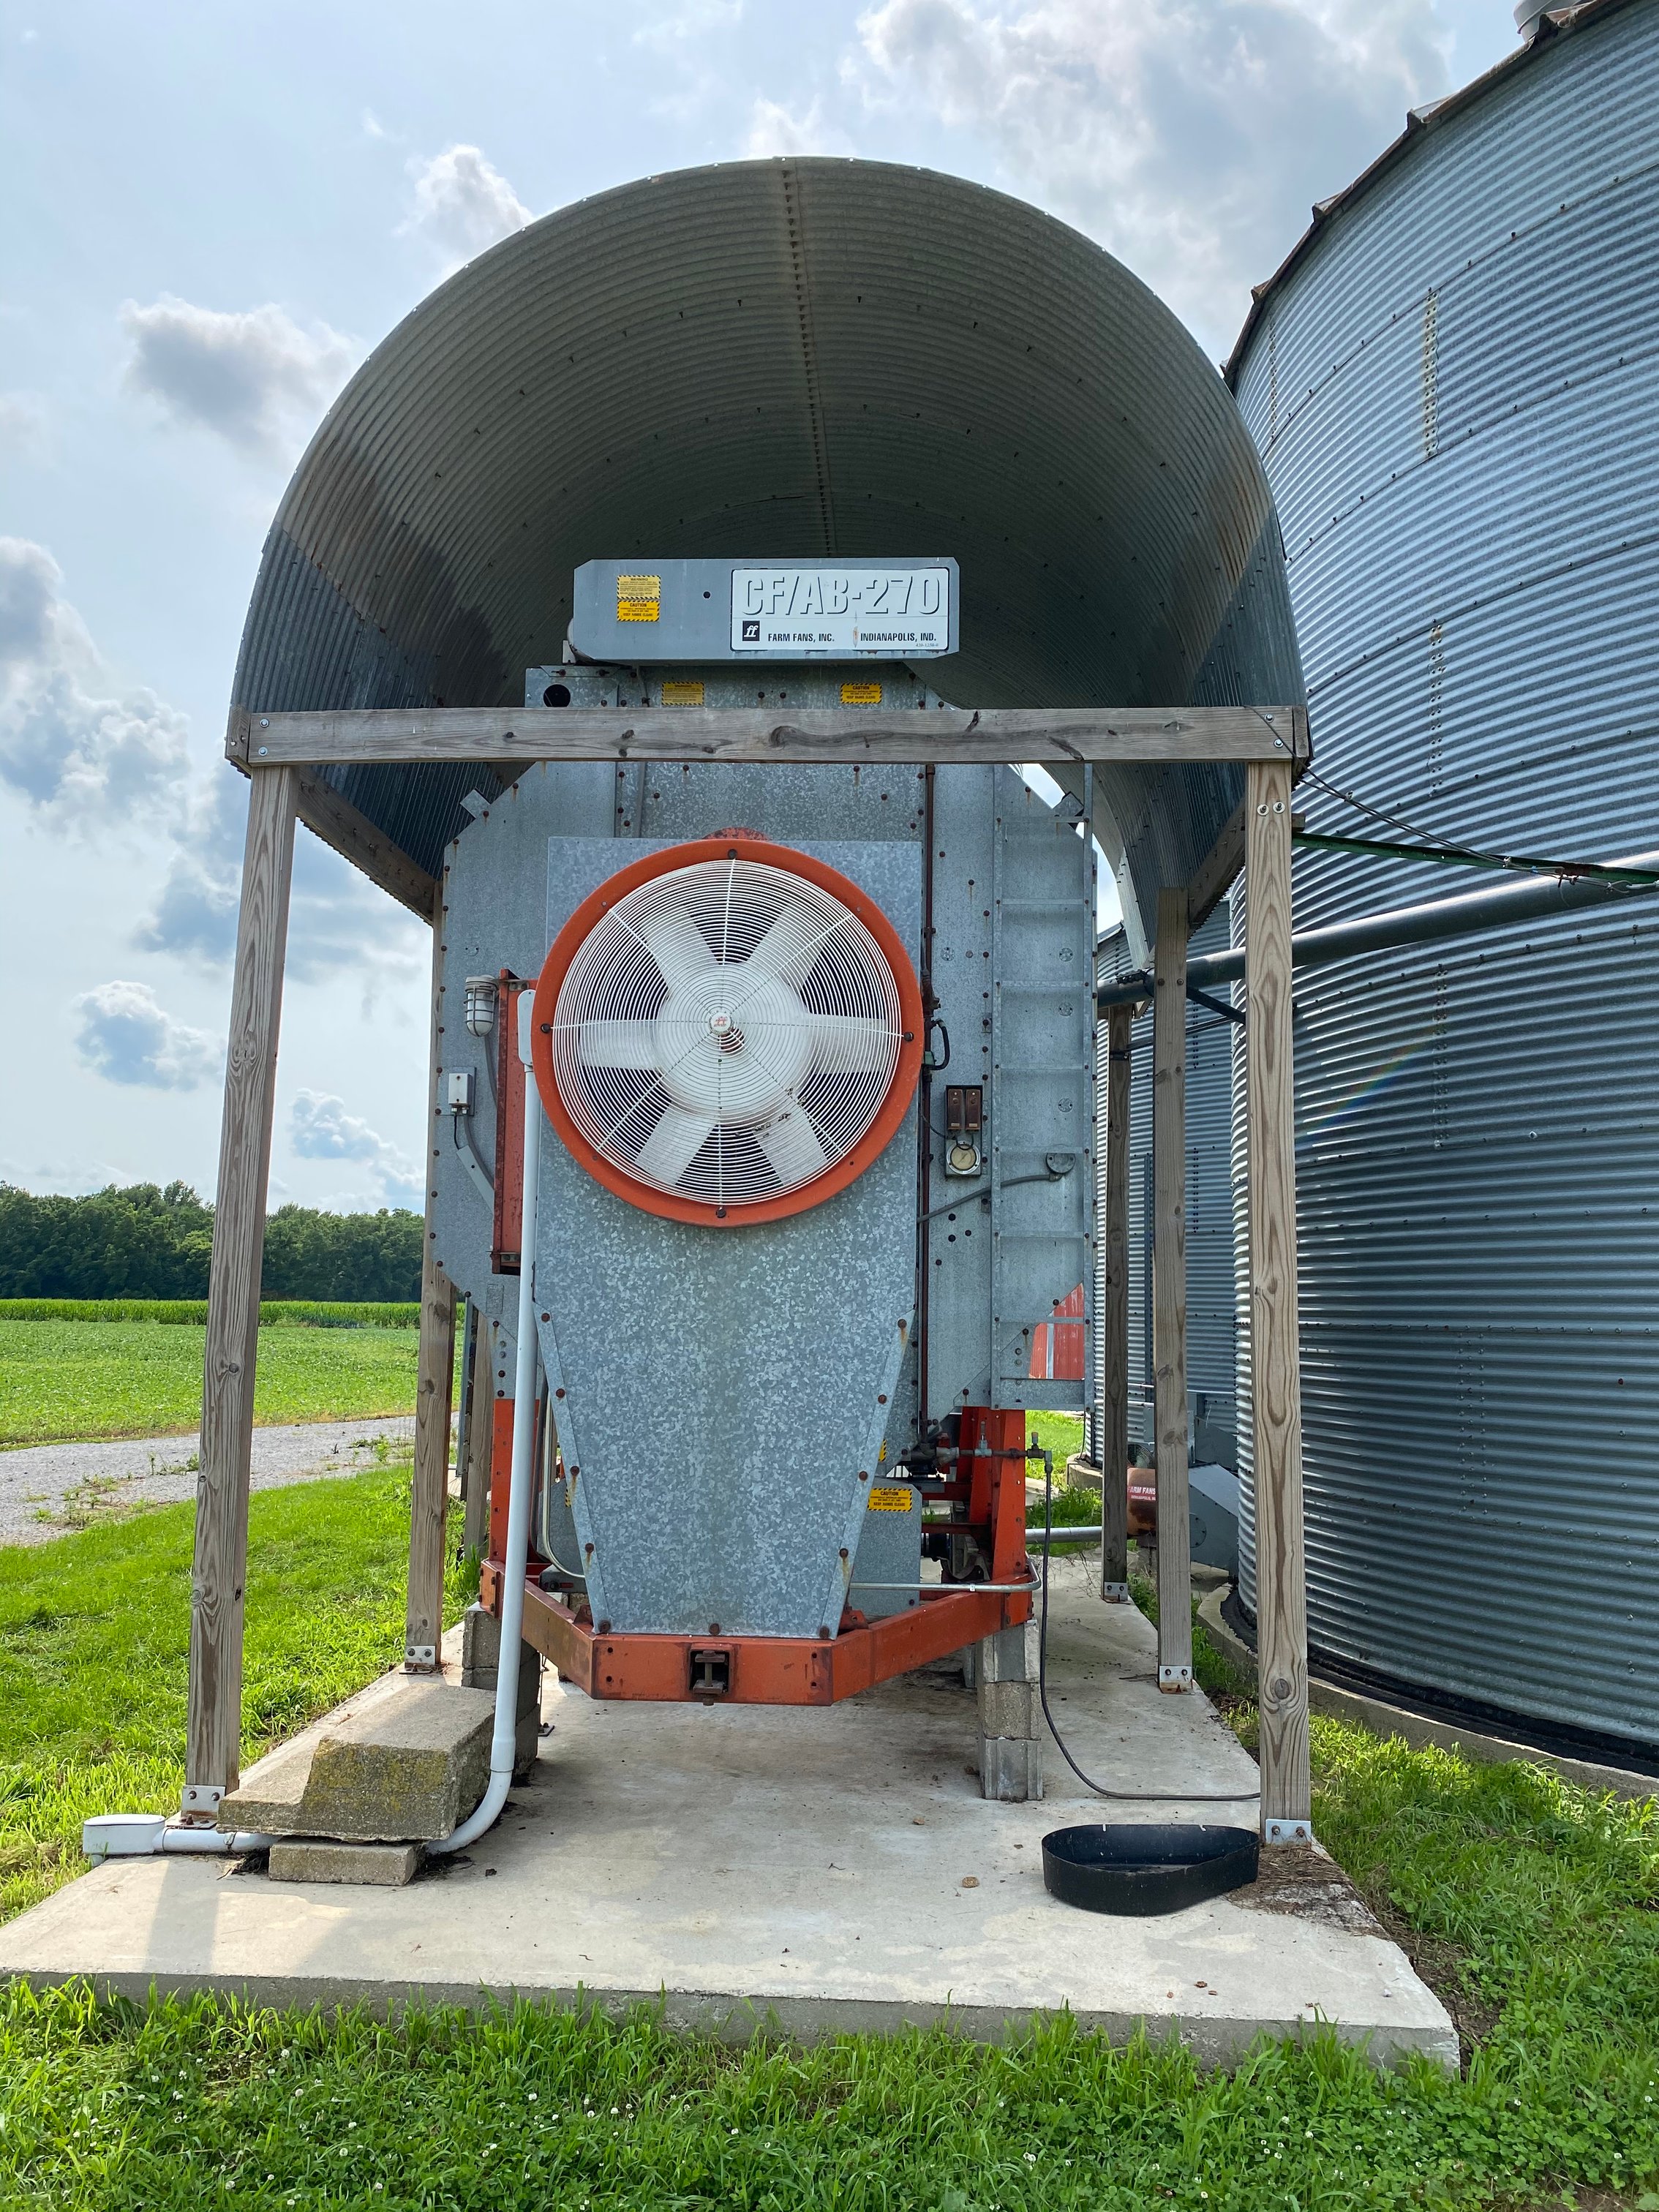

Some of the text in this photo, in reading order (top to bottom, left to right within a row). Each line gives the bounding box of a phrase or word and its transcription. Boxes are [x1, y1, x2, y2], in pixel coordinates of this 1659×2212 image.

[741, 576, 941, 616] CF/AB-270
[768, 633, 835, 643] FARM FANS, INC.
[860, 633, 937, 642] INDIANAPOLIS, IND.
